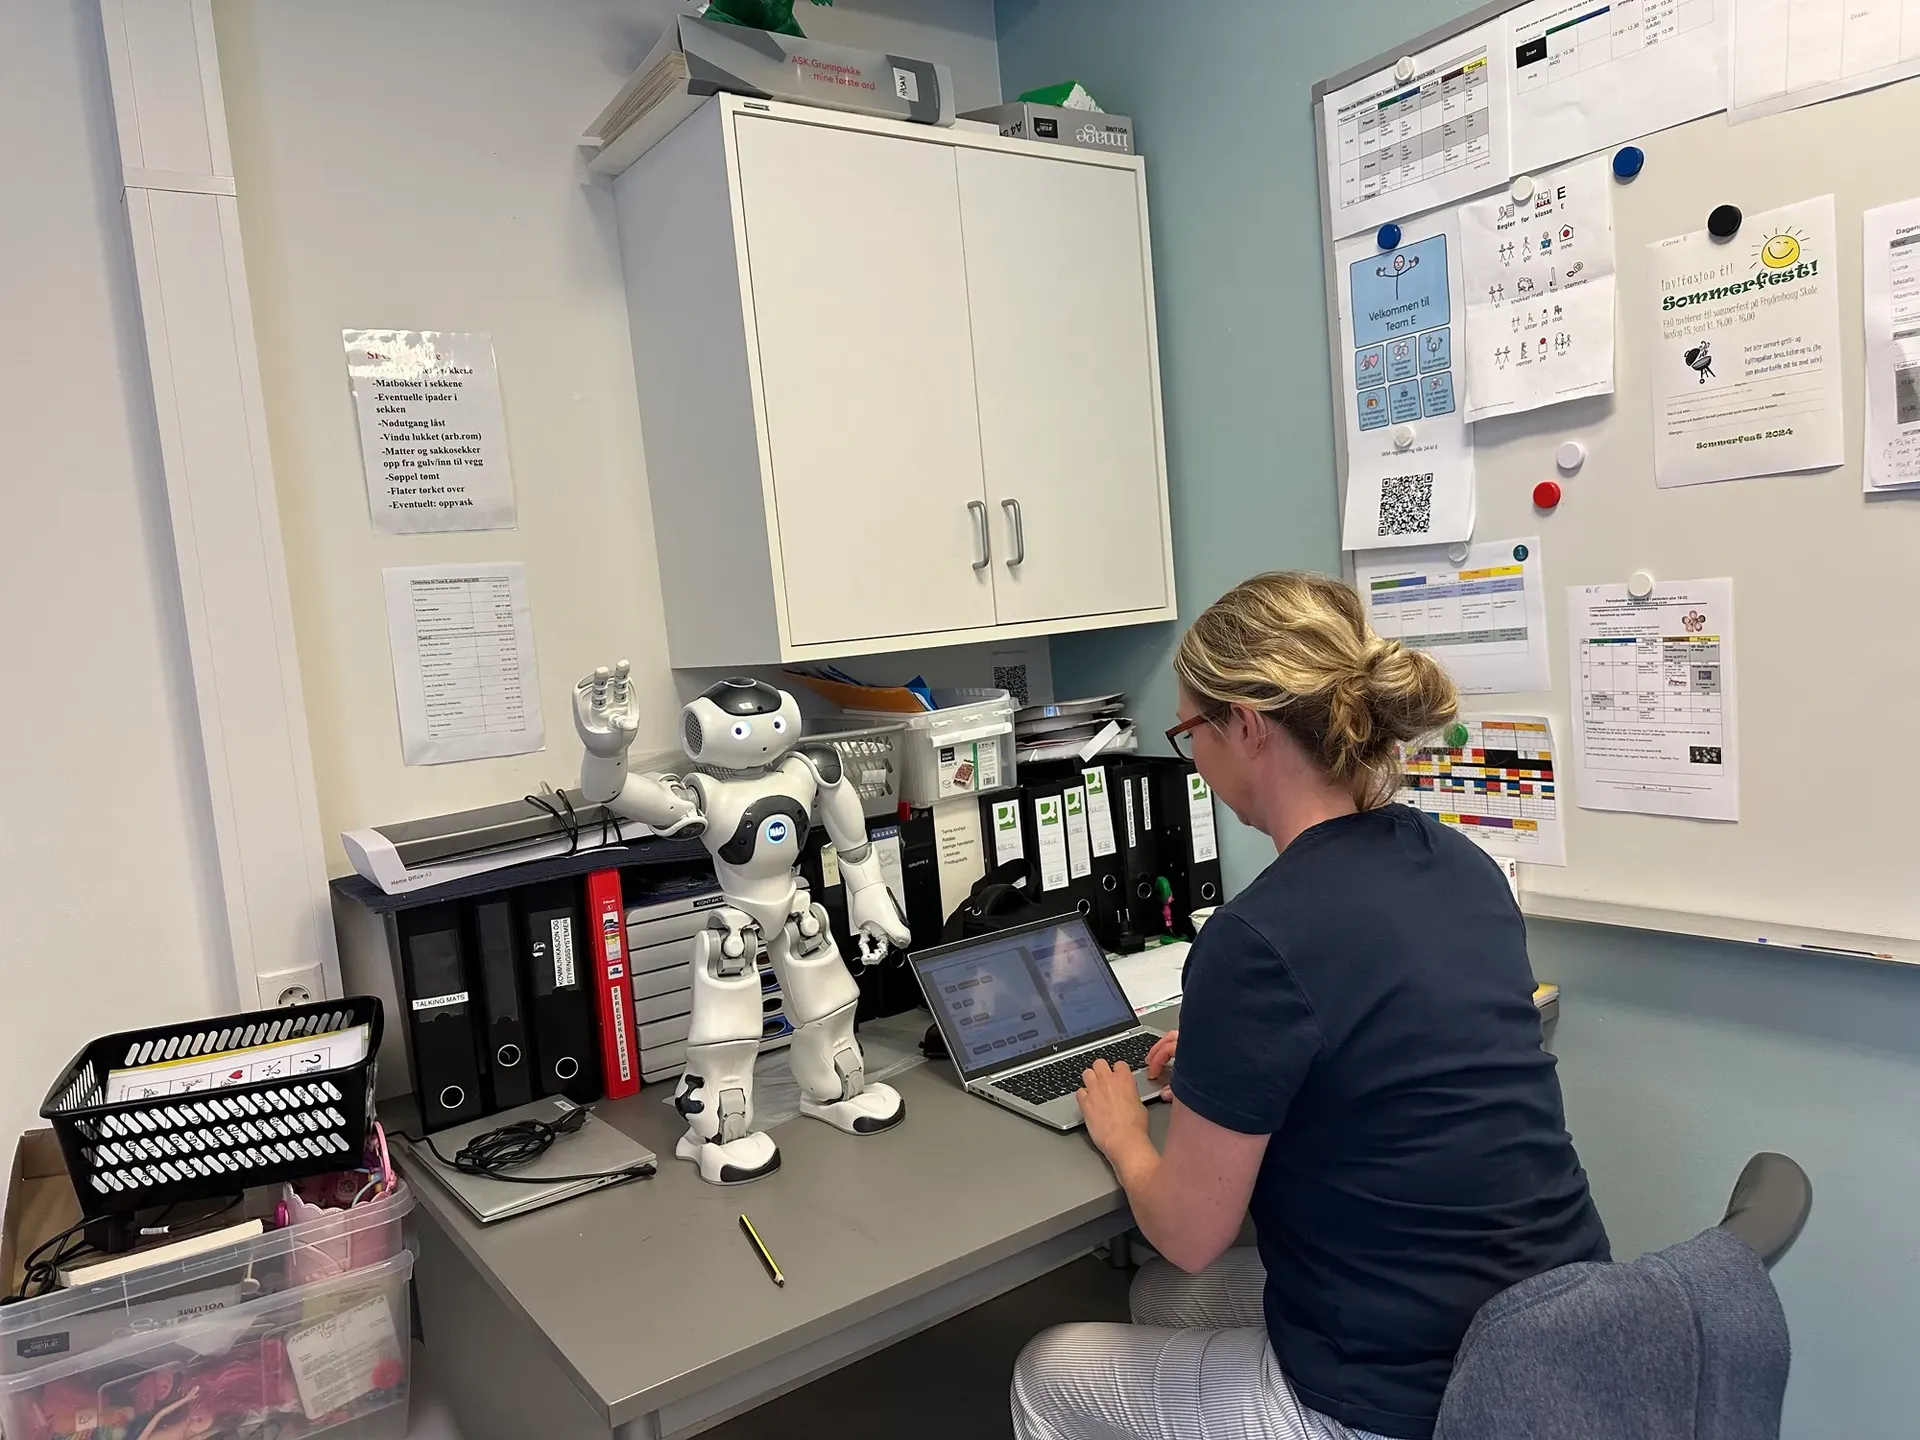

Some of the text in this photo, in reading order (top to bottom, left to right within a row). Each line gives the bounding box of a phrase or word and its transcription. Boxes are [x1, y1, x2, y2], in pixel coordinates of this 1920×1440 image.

[812, 59, 861, 75] Grunnpakke
[813, 72, 833, 84] mine
[861, 79, 875, 91] ord
[1076, 124, 1129, 152] image
[1557, 186, 1566, 200] E
[1497, 221, 1516, 231] Regler
[1535, 208, 1553, 218] klasse
[1523, 255, 1532, 263] går
[1540, 249, 1552, 257] rolig
[1661, 263, 1734, 292] Invitasjon til
[1510, 294, 1530, 304] snakker
[1564, 280, 1589, 289] stemme.
[1662, 259, 1819, 311] Sommerfest!
[1368, 296, 1430, 321] Velkommen til
[1704, 310, 1712, 320] til
[1713, 301, 1749, 317] sommerfest
[1751, 299, 1759, 311] på
[1799, 286, 1818, 297] Skole
[1385, 315, 1416, 331] Team E
[1524, 322, 1537, 330] sitter
[1763, 340, 1780, 348] servert
[1516, 359, 1532, 367] venter
[372, 379, 422, 388] -Matbokser
[430, 379, 463, 388] sekkene
[375, 393, 423, 401] -Eventuelle
[425, 394, 452, 403] ipader
[376, 406, 406, 414] sekken
[378, 419, 445, 429] -Nødutgang låst
[380, 432, 482, 442] -Vindu lukket (arb.rom)
[1696, 428, 1794, 450] Sommerfest 2024
[382, 446, 481, 456] -Matter og sakkosekker
[383, 458, 483, 469] opp fra gulv/inn til vegg
[385, 472, 440, 482] -Søppel tømt
[387, 486, 417, 495] -Flater
[419, 486, 445, 494] tørket
[389, 498, 473, 509] -Eventuelt: oppvask
[770, 826, 784, 836] NAO
[391, 876, 407, 886] Home
[408, 873, 424, 882] Office
[552, 919, 563, 985] KOMMUNIKASJON OG
[563, 919, 573, 984] STYRINGSSYSTEMER
[415, 994, 465, 1008] TALKING MATS
[613, 987, 629, 1078] BEREDSKAPSPERM
[176, 1302, 225, 1317] VOLUME
